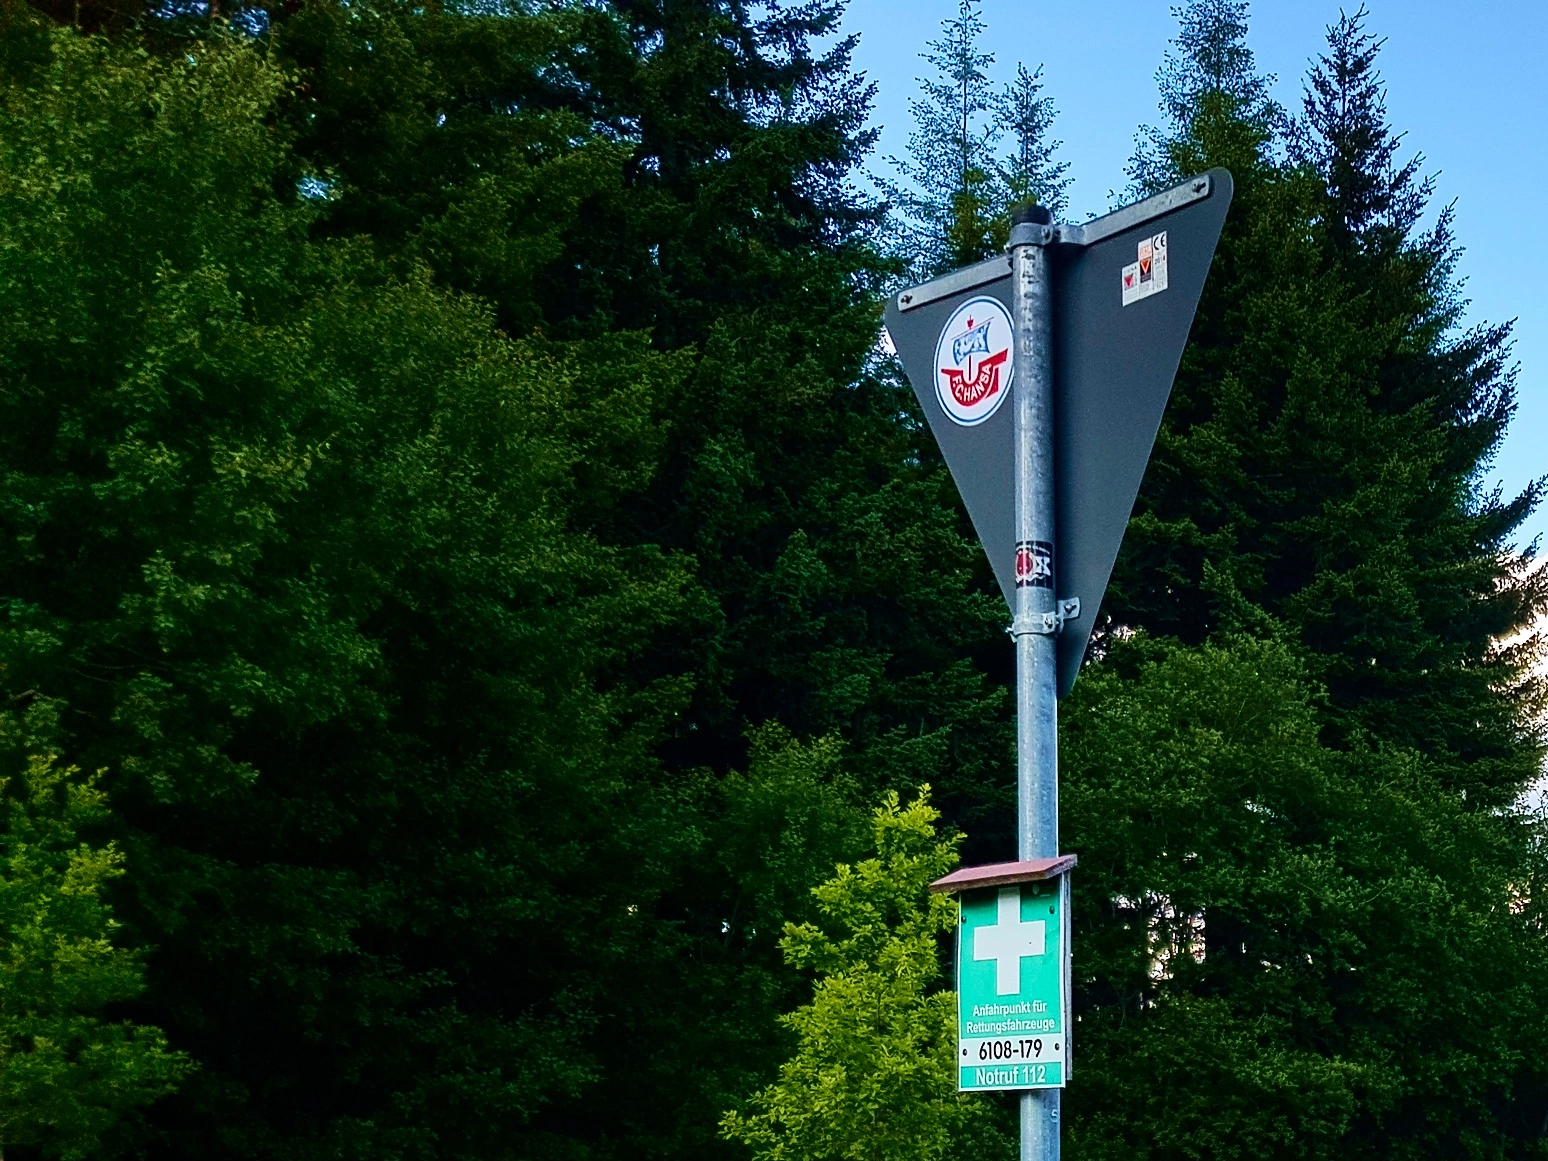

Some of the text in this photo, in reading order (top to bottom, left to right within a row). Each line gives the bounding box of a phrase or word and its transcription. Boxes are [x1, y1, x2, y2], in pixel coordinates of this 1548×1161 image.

[963, 363, 993, 402] HANSA
[972, 1000, 1047, 1017] Anfahrpunkt für
[966, 1018, 1055, 1034] Rettungsfahrzeuge
[979, 1039, 1042, 1060] 6108-179
[975, 1065, 1046, 1085] Notruf 112
